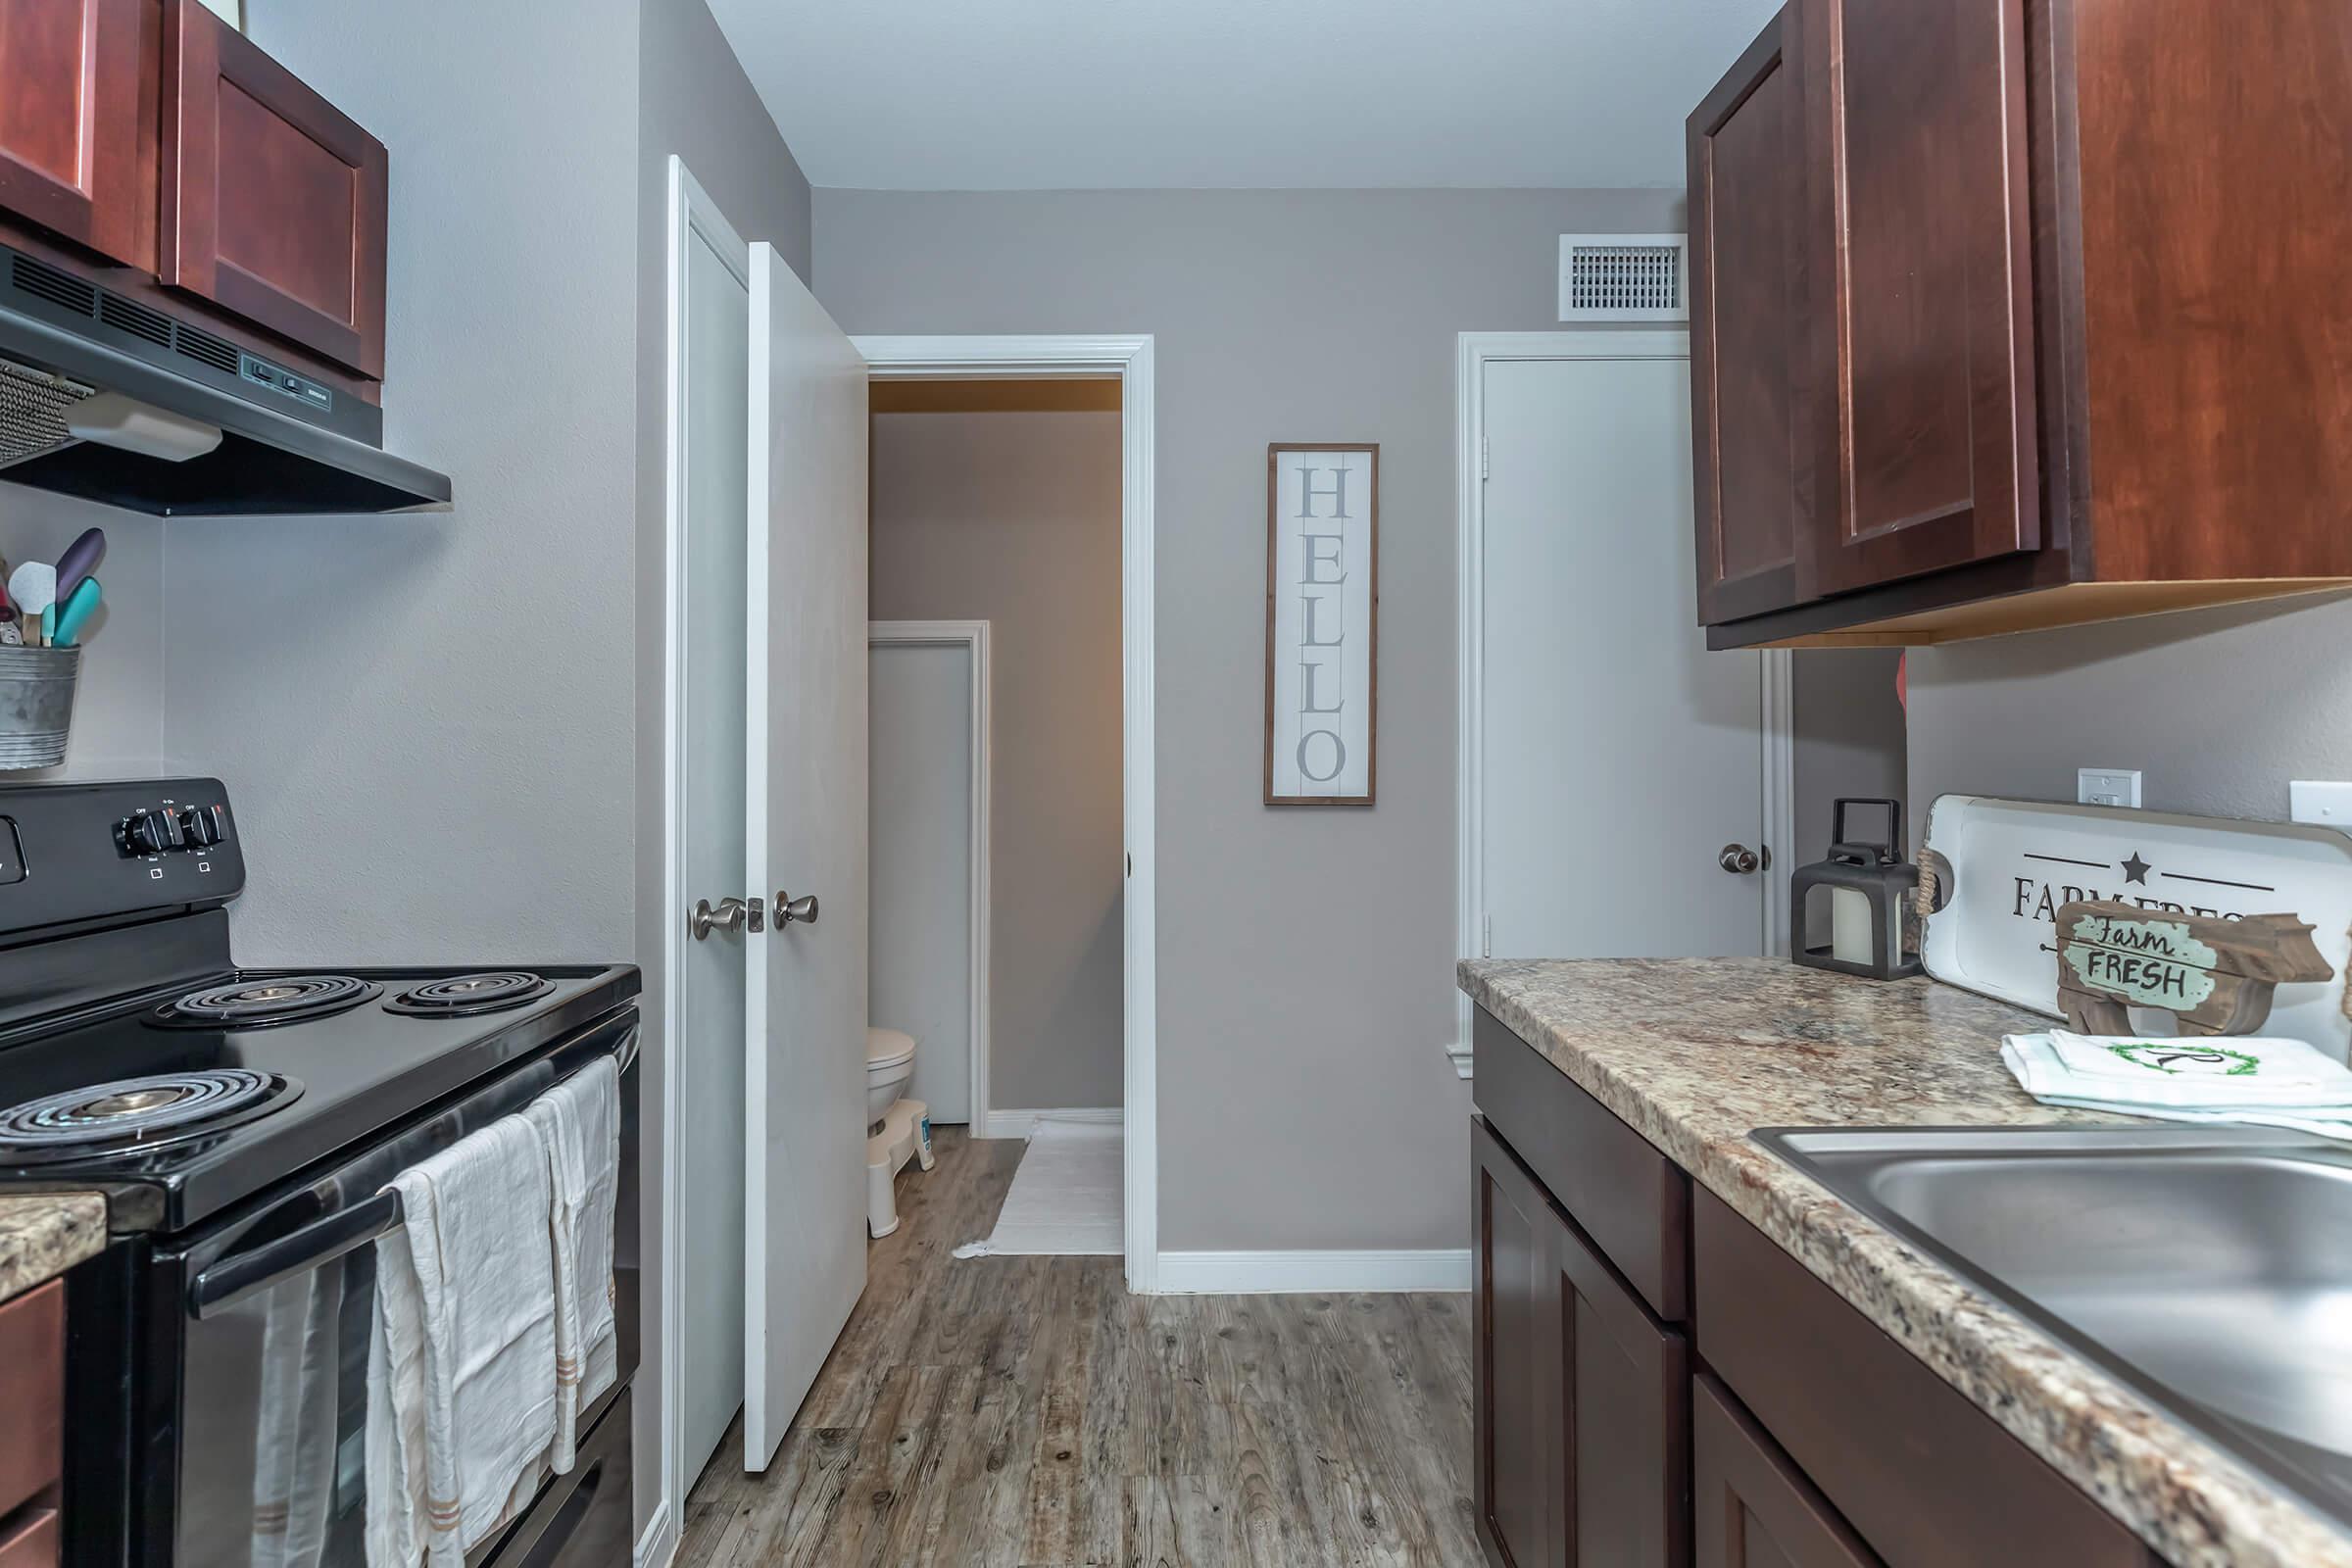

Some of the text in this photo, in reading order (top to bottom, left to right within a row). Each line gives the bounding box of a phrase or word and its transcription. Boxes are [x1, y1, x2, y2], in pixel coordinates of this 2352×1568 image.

[1294, 467, 1353, 781] HELLO
[2094, 916, 2176, 956] Farm
[2087, 951, 2186, 999] FRESH
